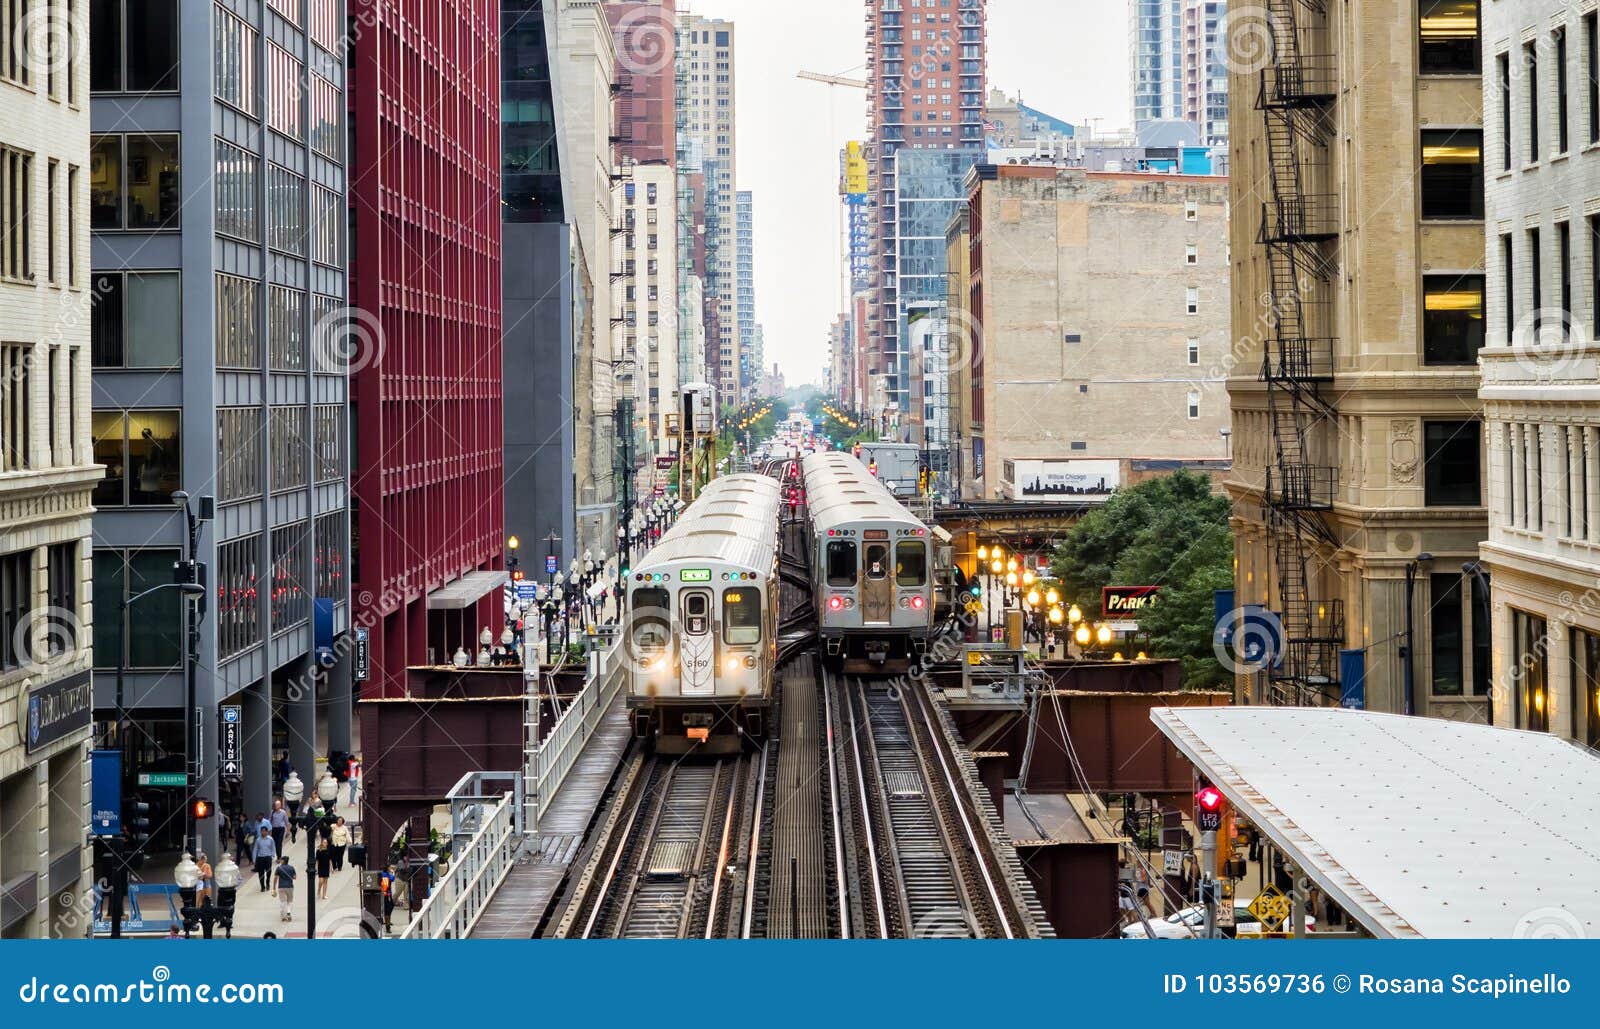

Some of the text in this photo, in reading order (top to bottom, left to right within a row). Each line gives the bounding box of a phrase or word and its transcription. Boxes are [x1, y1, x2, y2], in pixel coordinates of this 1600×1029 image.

[1065, 473, 1087, 481] Chicago
[726, 593, 741, 603] 616
[687, 660, 708, 668] 5160
[227, 711, 235, 720] P
[227, 723, 235, 760] PARKING
[1202, 813, 1218, 821] LP2
[1203, 820, 1217, 828] 110
[1166, 851, 1180, 859] ONE
